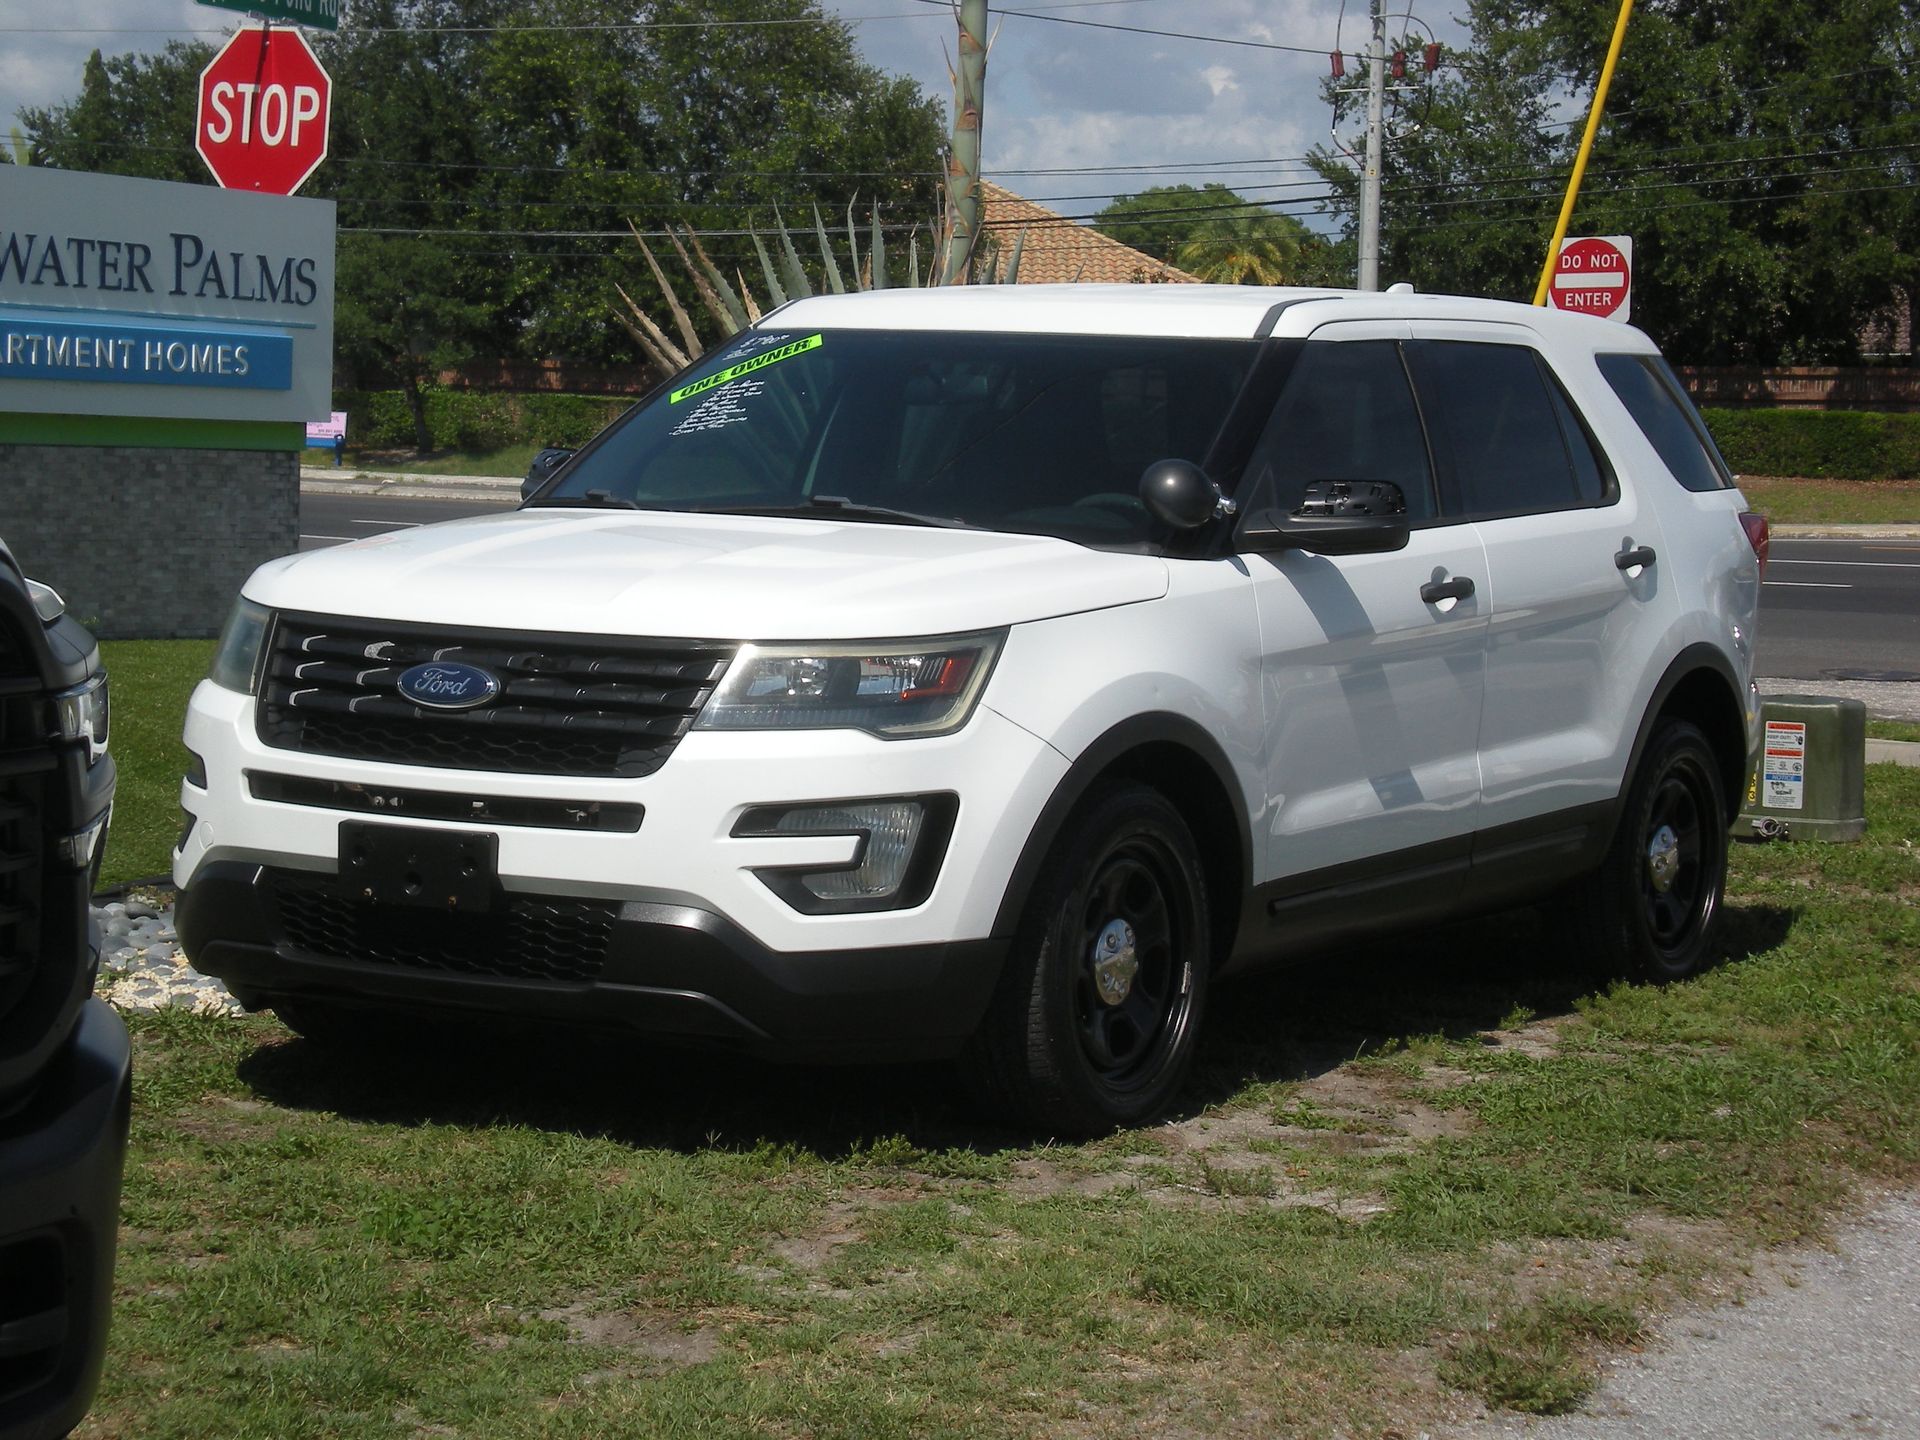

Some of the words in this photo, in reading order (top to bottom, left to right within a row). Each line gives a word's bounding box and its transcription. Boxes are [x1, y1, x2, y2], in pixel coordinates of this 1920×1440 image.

[207, 81, 320, 147] STOP
[168, 233, 317, 306] PALMS
[1562, 255, 1582, 269] DO
[1590, 253, 1619, 268] NOT
[1565, 292, 1612, 307] ENTER
[0, 332, 135, 370] RTMENT
[144, 340, 249, 376] HOMES
[679, 372, 728, 398] ONE
[730, 338, 813, 376] OWNER
[414, 667, 472, 695] Ford
